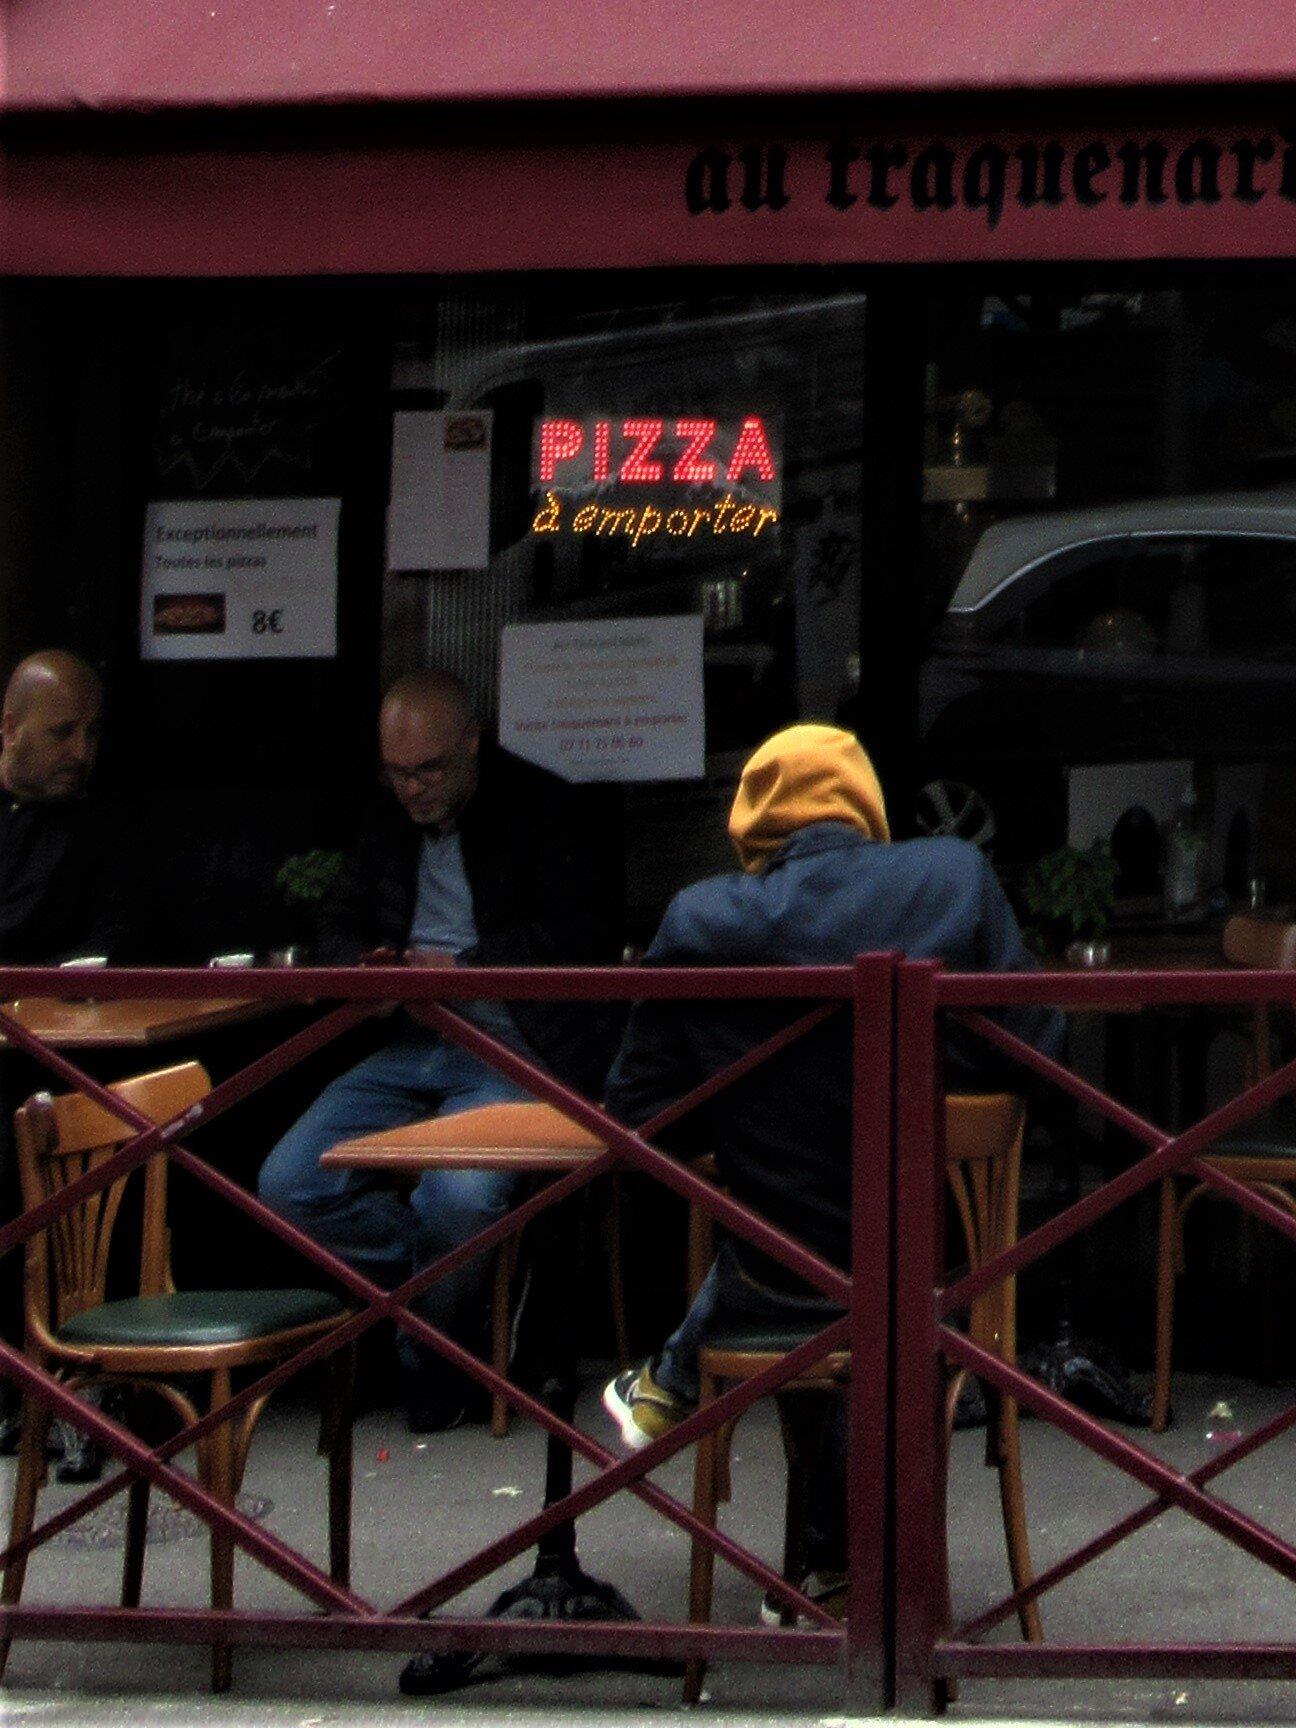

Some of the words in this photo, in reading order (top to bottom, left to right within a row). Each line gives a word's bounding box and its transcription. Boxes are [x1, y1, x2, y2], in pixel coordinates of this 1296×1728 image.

[684, 146, 789, 215] au
[538, 417, 776, 483] PIZZA
[531, 492, 562, 534] à
[572, 494, 780, 547] emporter
[251, 609, 285, 635] 8€
